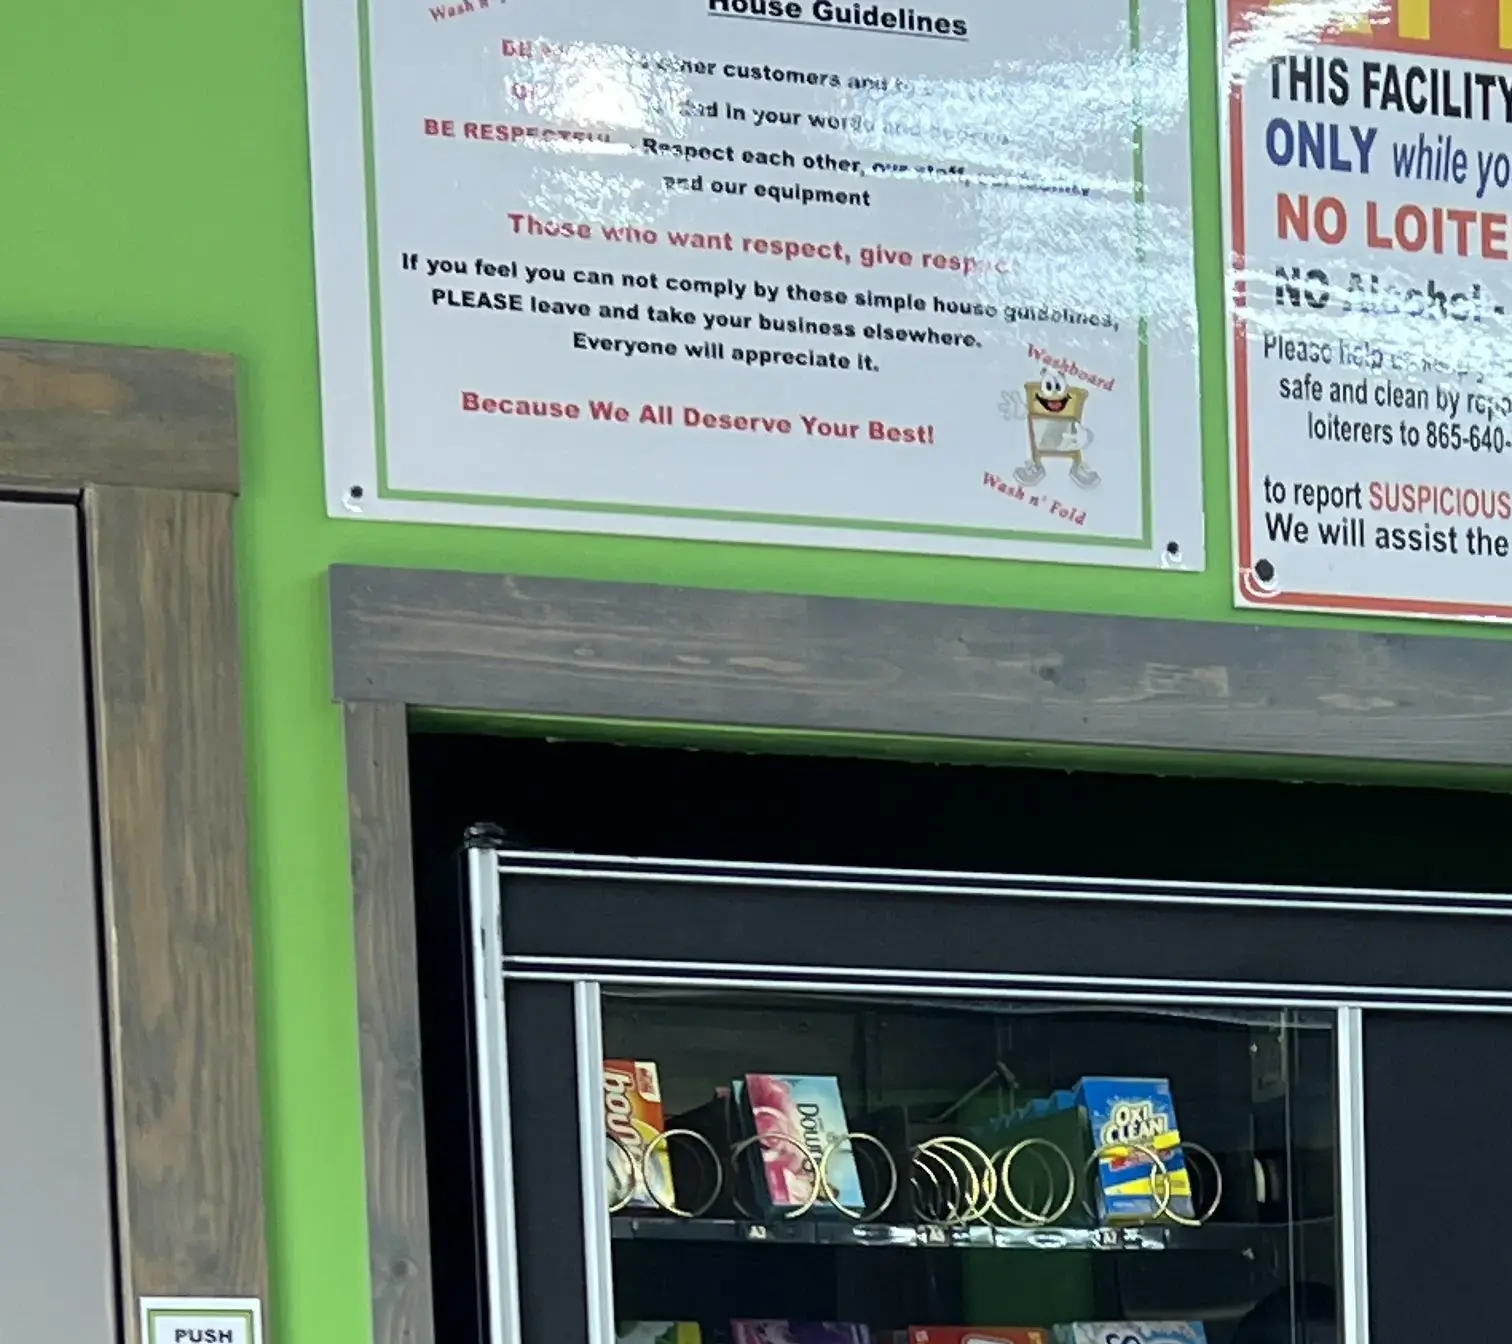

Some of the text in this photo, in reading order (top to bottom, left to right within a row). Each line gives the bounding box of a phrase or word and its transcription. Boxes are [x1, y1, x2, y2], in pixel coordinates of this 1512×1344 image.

[813, 0, 968, 37] Guidelines
[723, 61, 841, 89] customers
[1270, 54, 1349, 106] THIS
[743, 146, 865, 177] each other,
[1266, 117, 1378, 175] ONLY
[1393, 132, 1467, 184] while
[755, 183, 870, 207] equipment
[1276, 192, 1348, 246] NO
[668, 229, 912, 268] want respect, give
[402, 253, 926, 312] If you feel you can not comply by these simple
[432, 288, 983, 349] PLEASE leave and take your business elsewhere.
[462, 391, 935, 445] Because We All Deserve Your Best!
[1308, 412, 1393, 446] loiterers
[1400, 420, 1420, 447] to
[1369, 480, 1511, 519] SUSPICIOUS
[1106, 1117, 1164, 1145] CLEAN
[1115, 1105, 1149, 1125] OXI
[175, 1329, 233, 1343] PUSH
